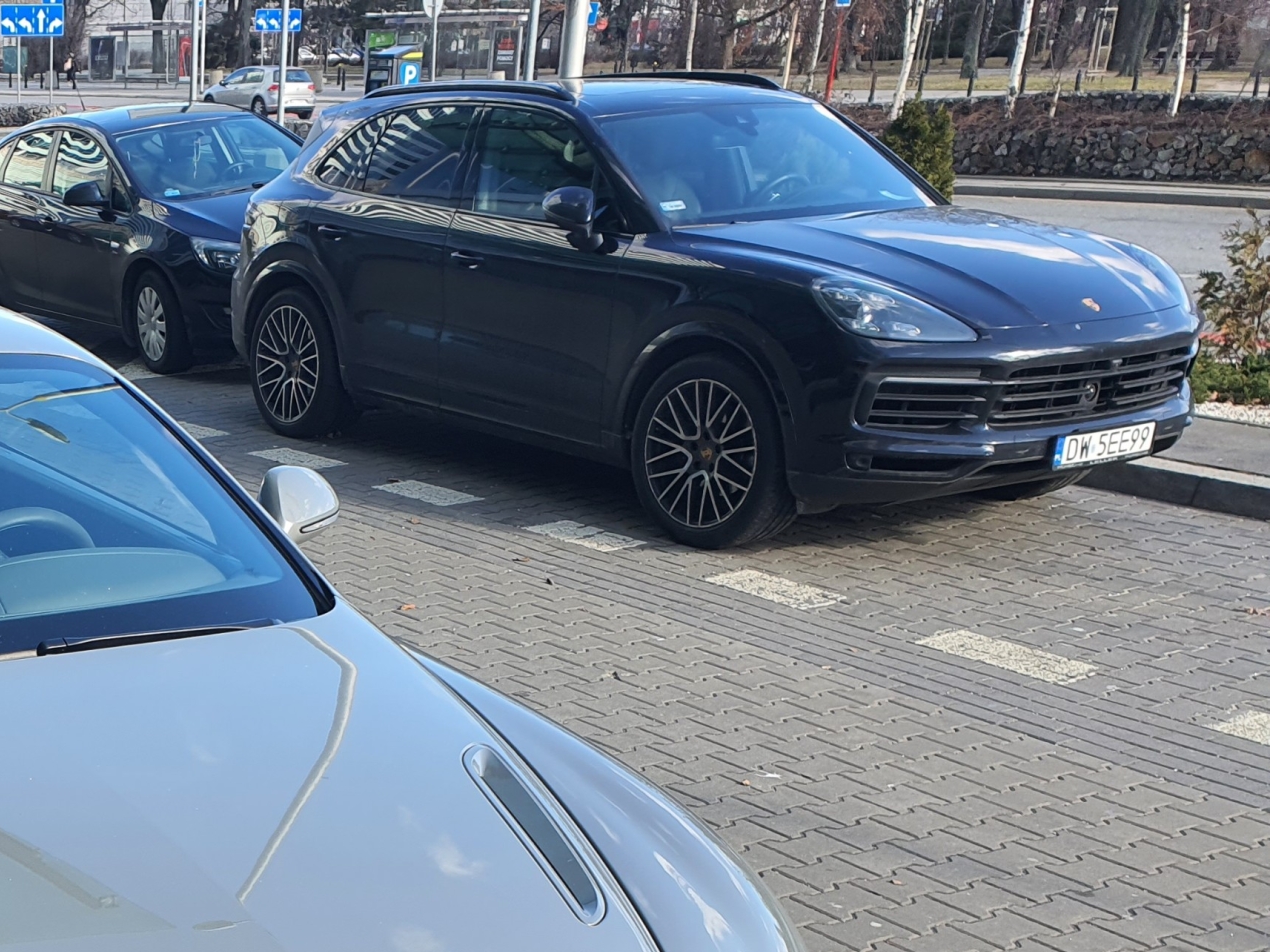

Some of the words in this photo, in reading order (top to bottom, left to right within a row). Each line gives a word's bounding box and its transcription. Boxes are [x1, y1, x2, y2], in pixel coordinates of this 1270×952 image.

[404, 64, 417, 85] P
[1066, 435, 1093, 461] DW
[1096, 426, 1150, 457] 5EE99
